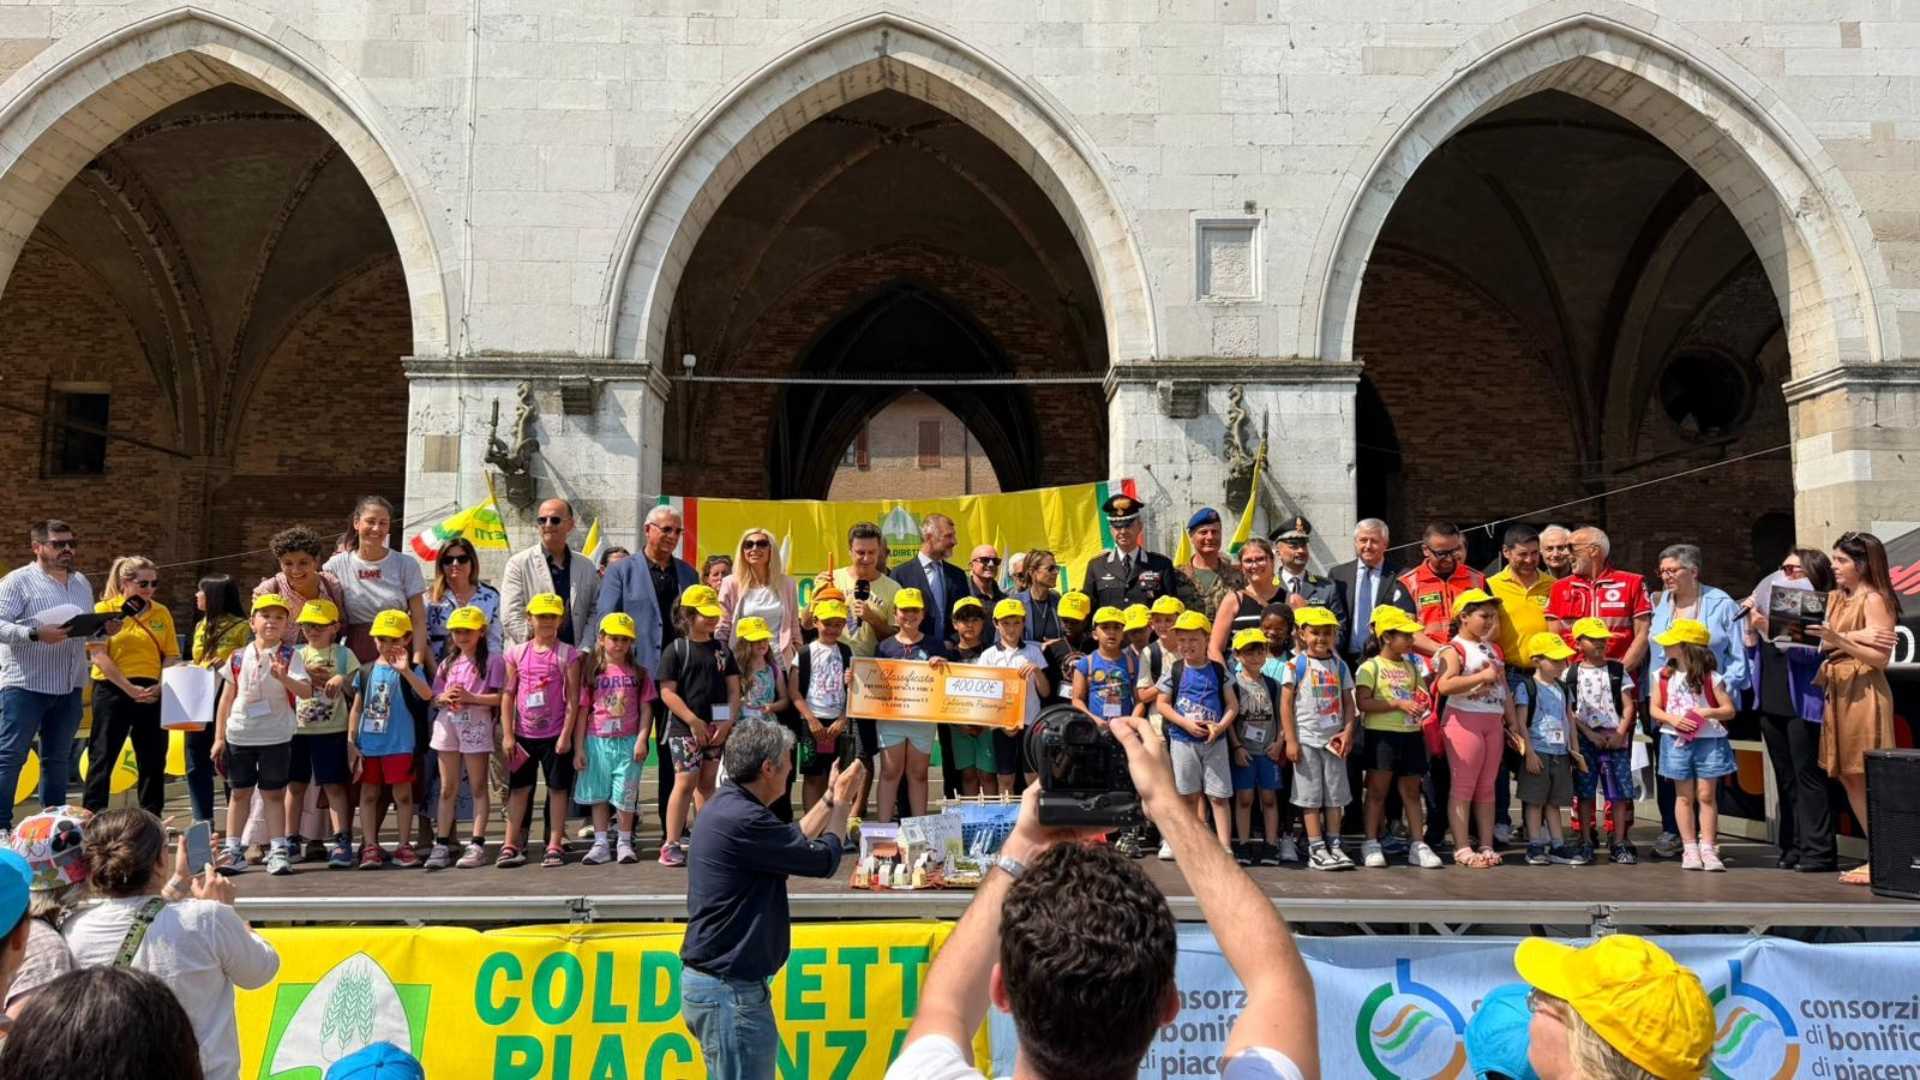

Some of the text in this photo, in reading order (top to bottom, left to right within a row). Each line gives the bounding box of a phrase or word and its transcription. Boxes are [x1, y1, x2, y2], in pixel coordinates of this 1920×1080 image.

[475, 947, 930, 1026] COLDETT
[1800, 994, 1920, 1019] consorzi
[1806, 1023, 1920, 1050] di bonific
[492, 1029, 907, 1080] PIACNZ
[1812, 1056, 1920, 1080] di piacen
